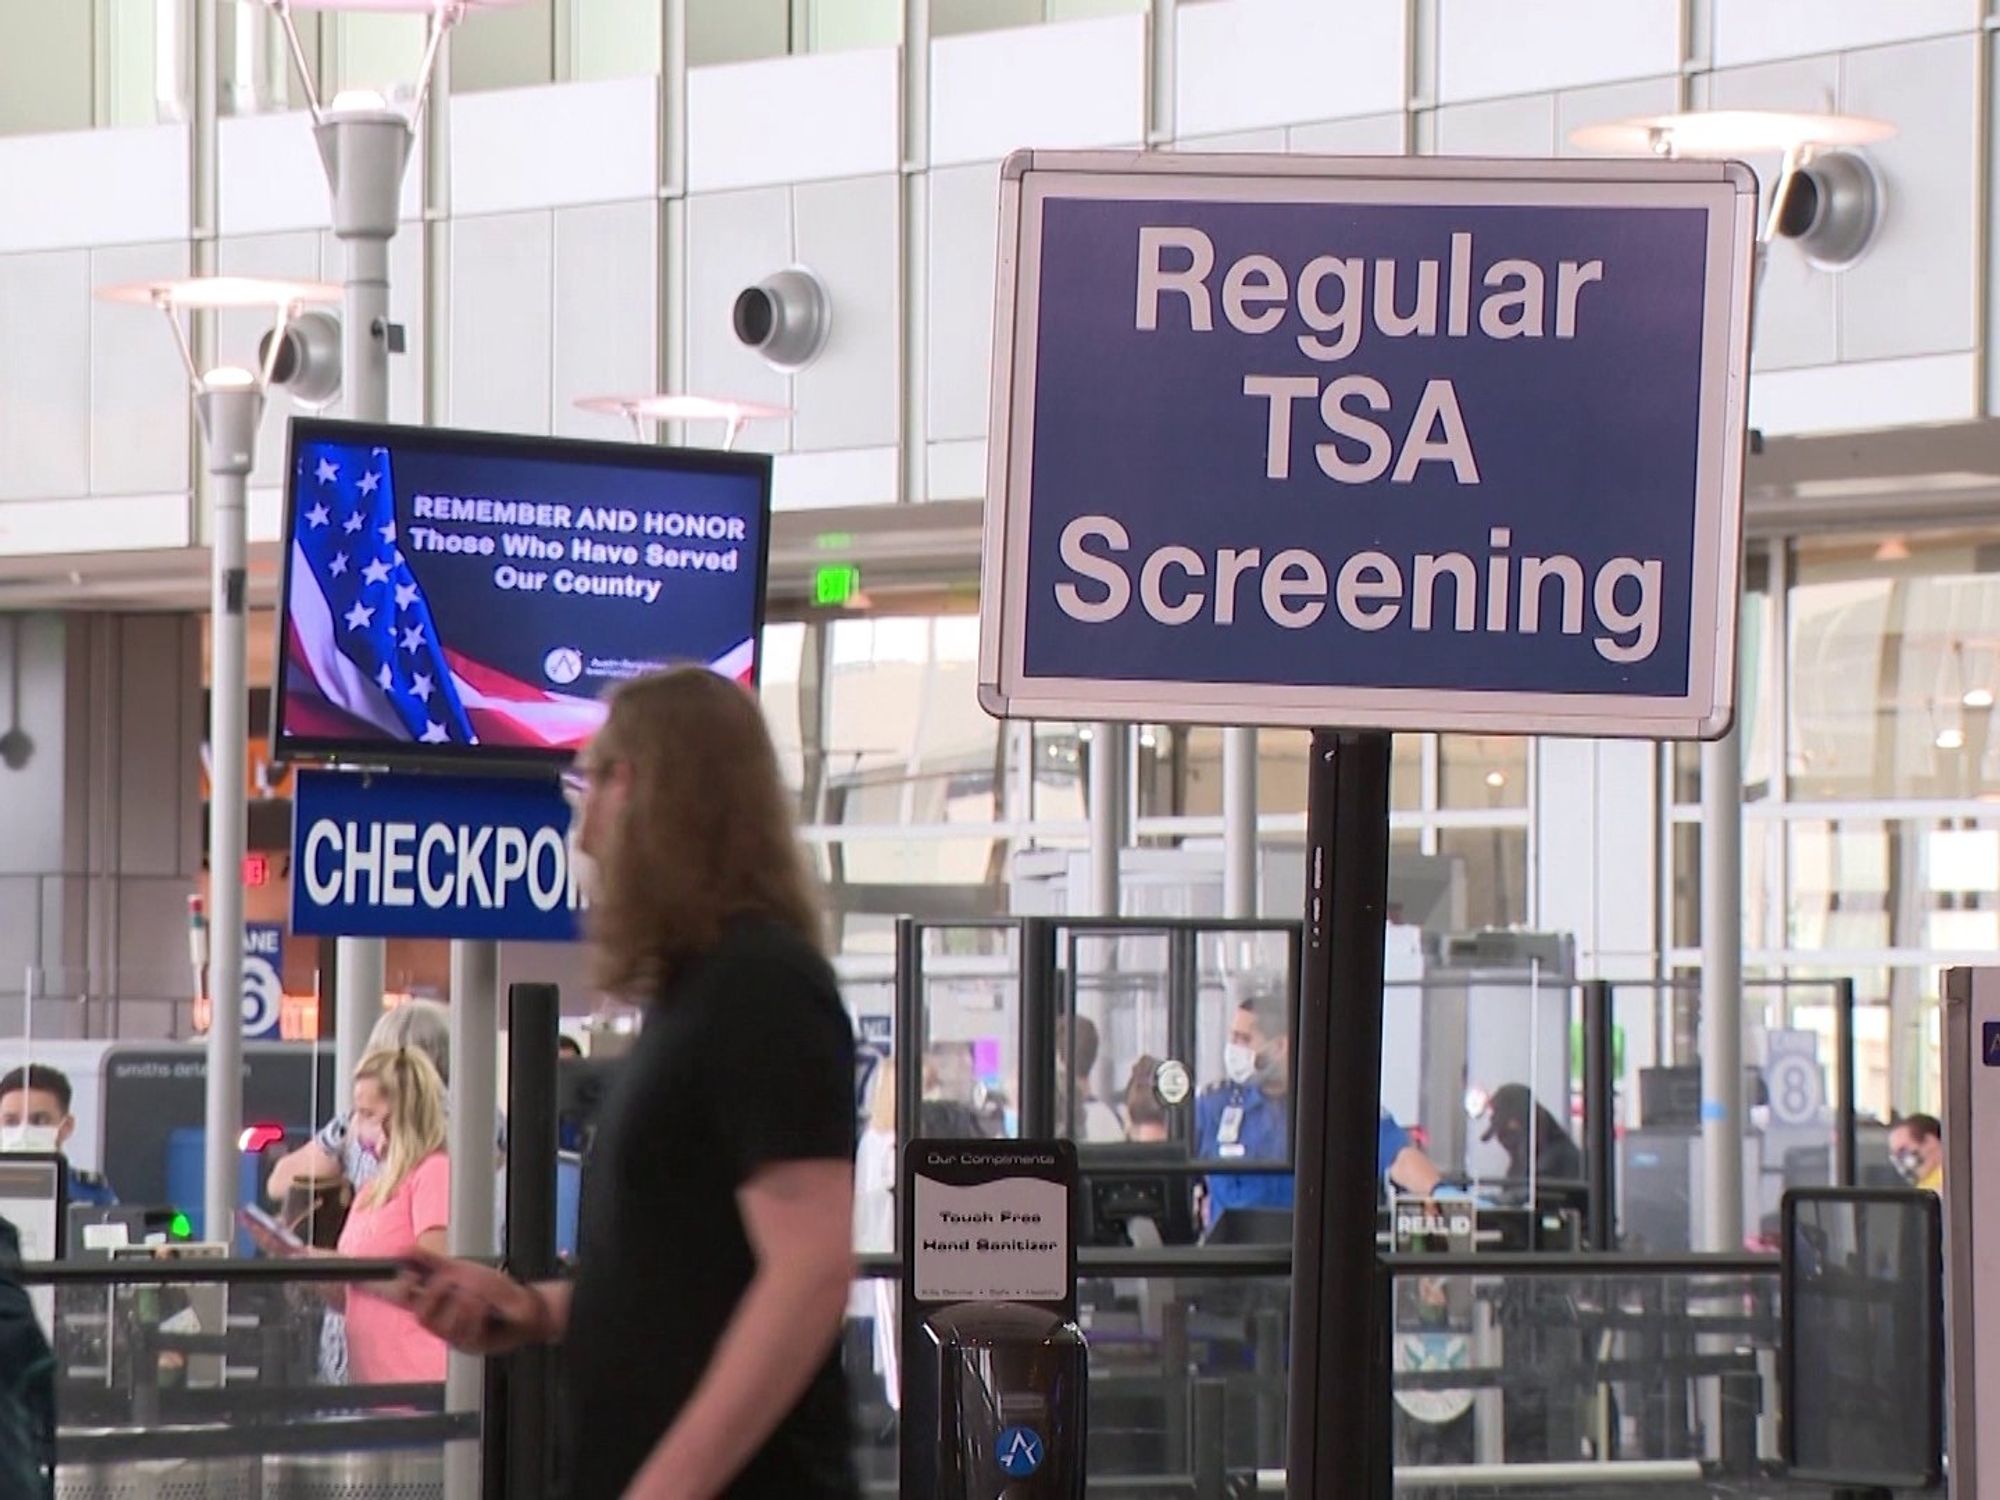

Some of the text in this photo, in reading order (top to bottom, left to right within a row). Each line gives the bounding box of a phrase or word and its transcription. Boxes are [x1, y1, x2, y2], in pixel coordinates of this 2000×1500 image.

[1135, 226, 1603, 361] Regular
[1243, 374, 1481, 484] TSA
[414, 496, 746, 541] REMEMBER AND HONOR
[409, 527, 738, 572] Those Who Have Served
[494, 565, 663, 603] Our Country
[1054, 515, 1663, 662] Screening
[304, 818, 589, 912] CHECKPOI
[1783, 1065, 1808, 1115] 8
[927, 1152, 1055, 1167] Our Compliments
[939, 1211, 1041, 1223] Touch Free
[1397, 1215, 1470, 1235] REAL ID
[923, 1239, 1058, 1251] Hand Sanitizer
